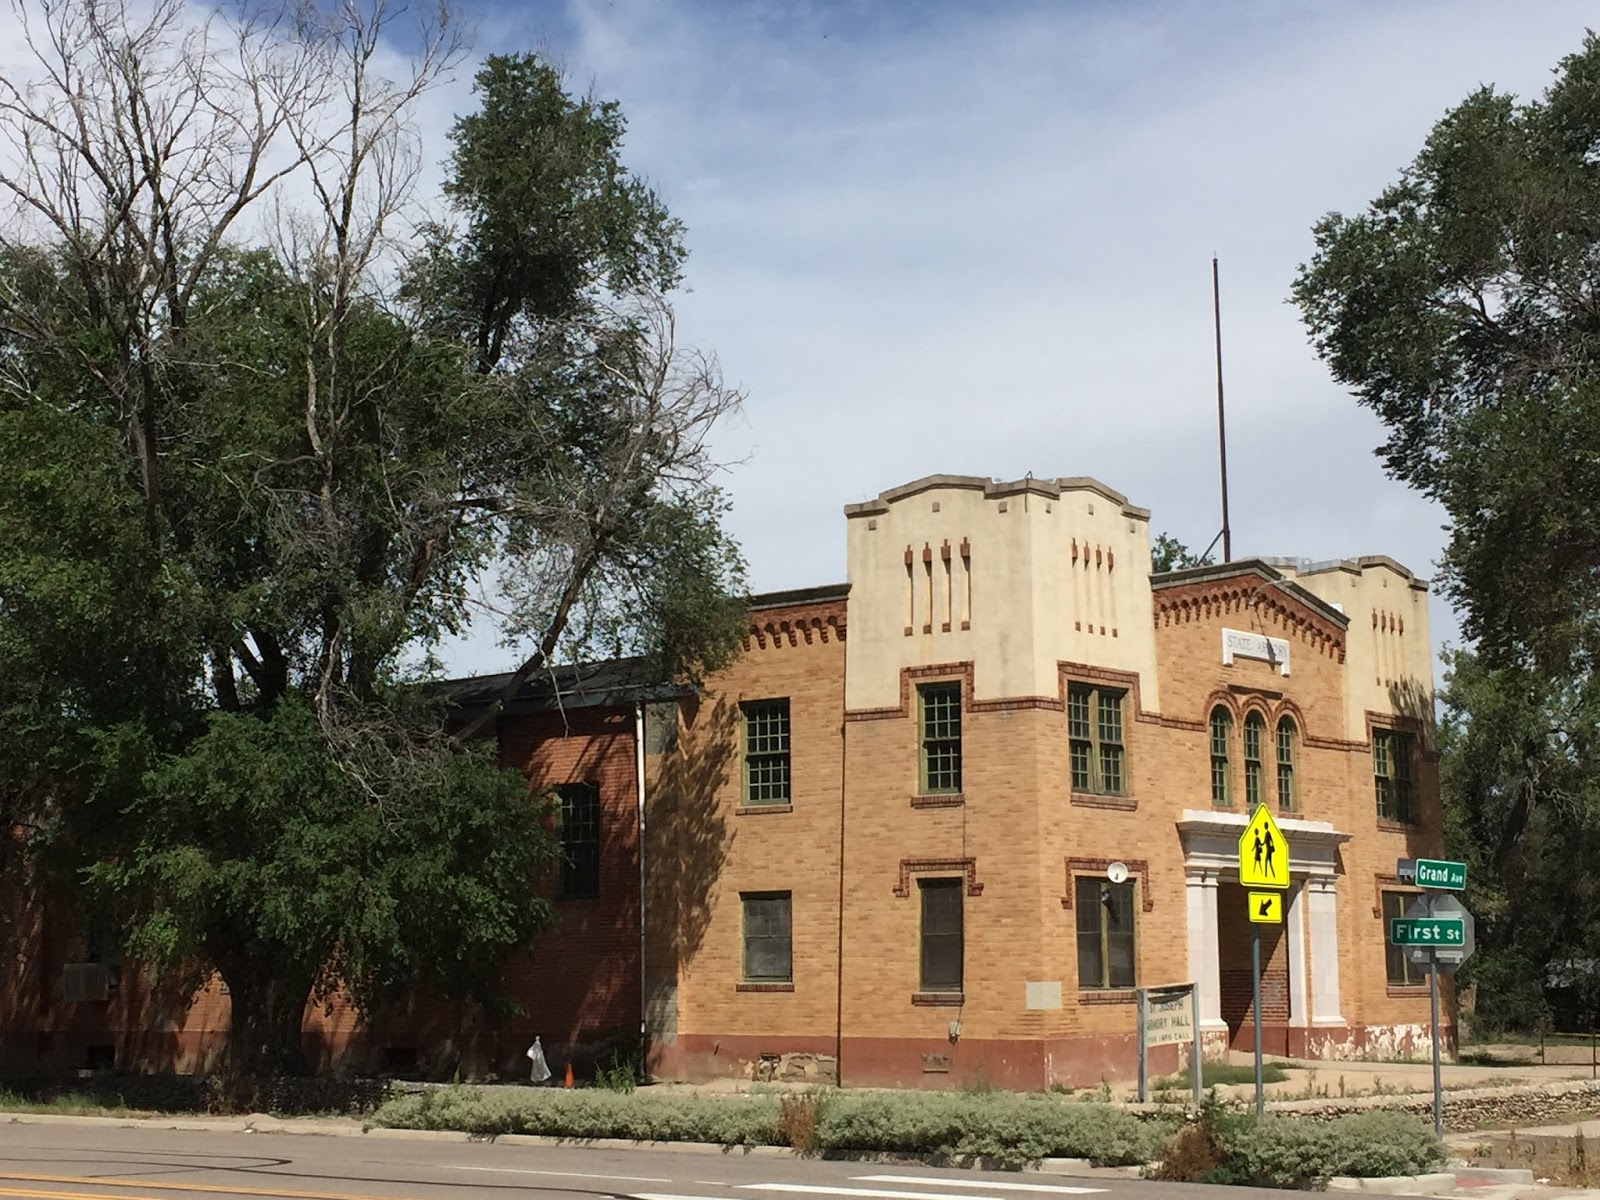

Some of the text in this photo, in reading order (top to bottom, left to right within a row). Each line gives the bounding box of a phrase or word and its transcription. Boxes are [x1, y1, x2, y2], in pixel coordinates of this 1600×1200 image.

[1227, 635, 1287, 658] STATE ARORY
[1419, 865, 1463, 884] Grand Ave
[1396, 924, 1461, 941] First St
[1171, 1015, 1191, 1028] HALL
[1174, 1032, 1190, 1041] CALL
